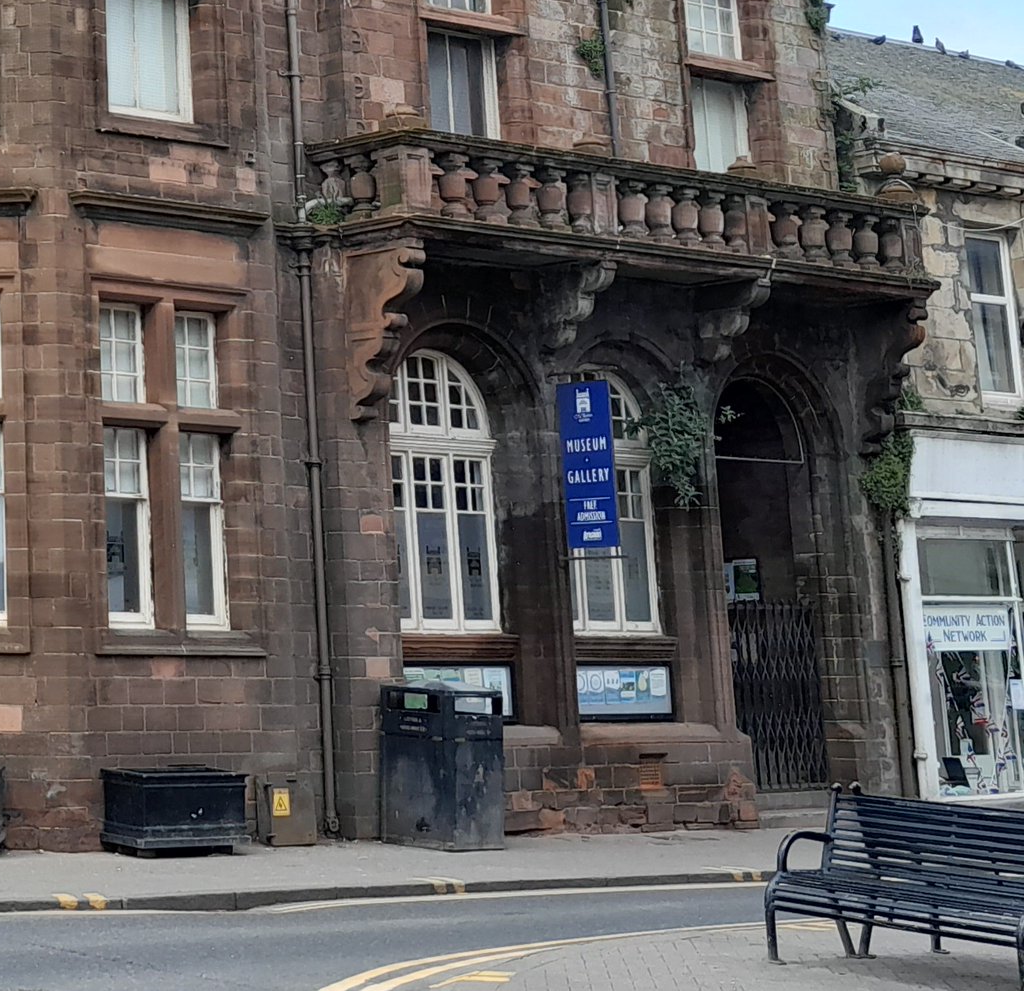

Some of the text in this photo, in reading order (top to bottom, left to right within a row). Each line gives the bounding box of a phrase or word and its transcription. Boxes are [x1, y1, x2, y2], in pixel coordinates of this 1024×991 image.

[566, 435, 607, 453] MUSEUM
[567, 467, 610, 484] GALLERY
[975, 613, 1006, 626] ACTION
[942, 629, 988, 642] NETWORK
